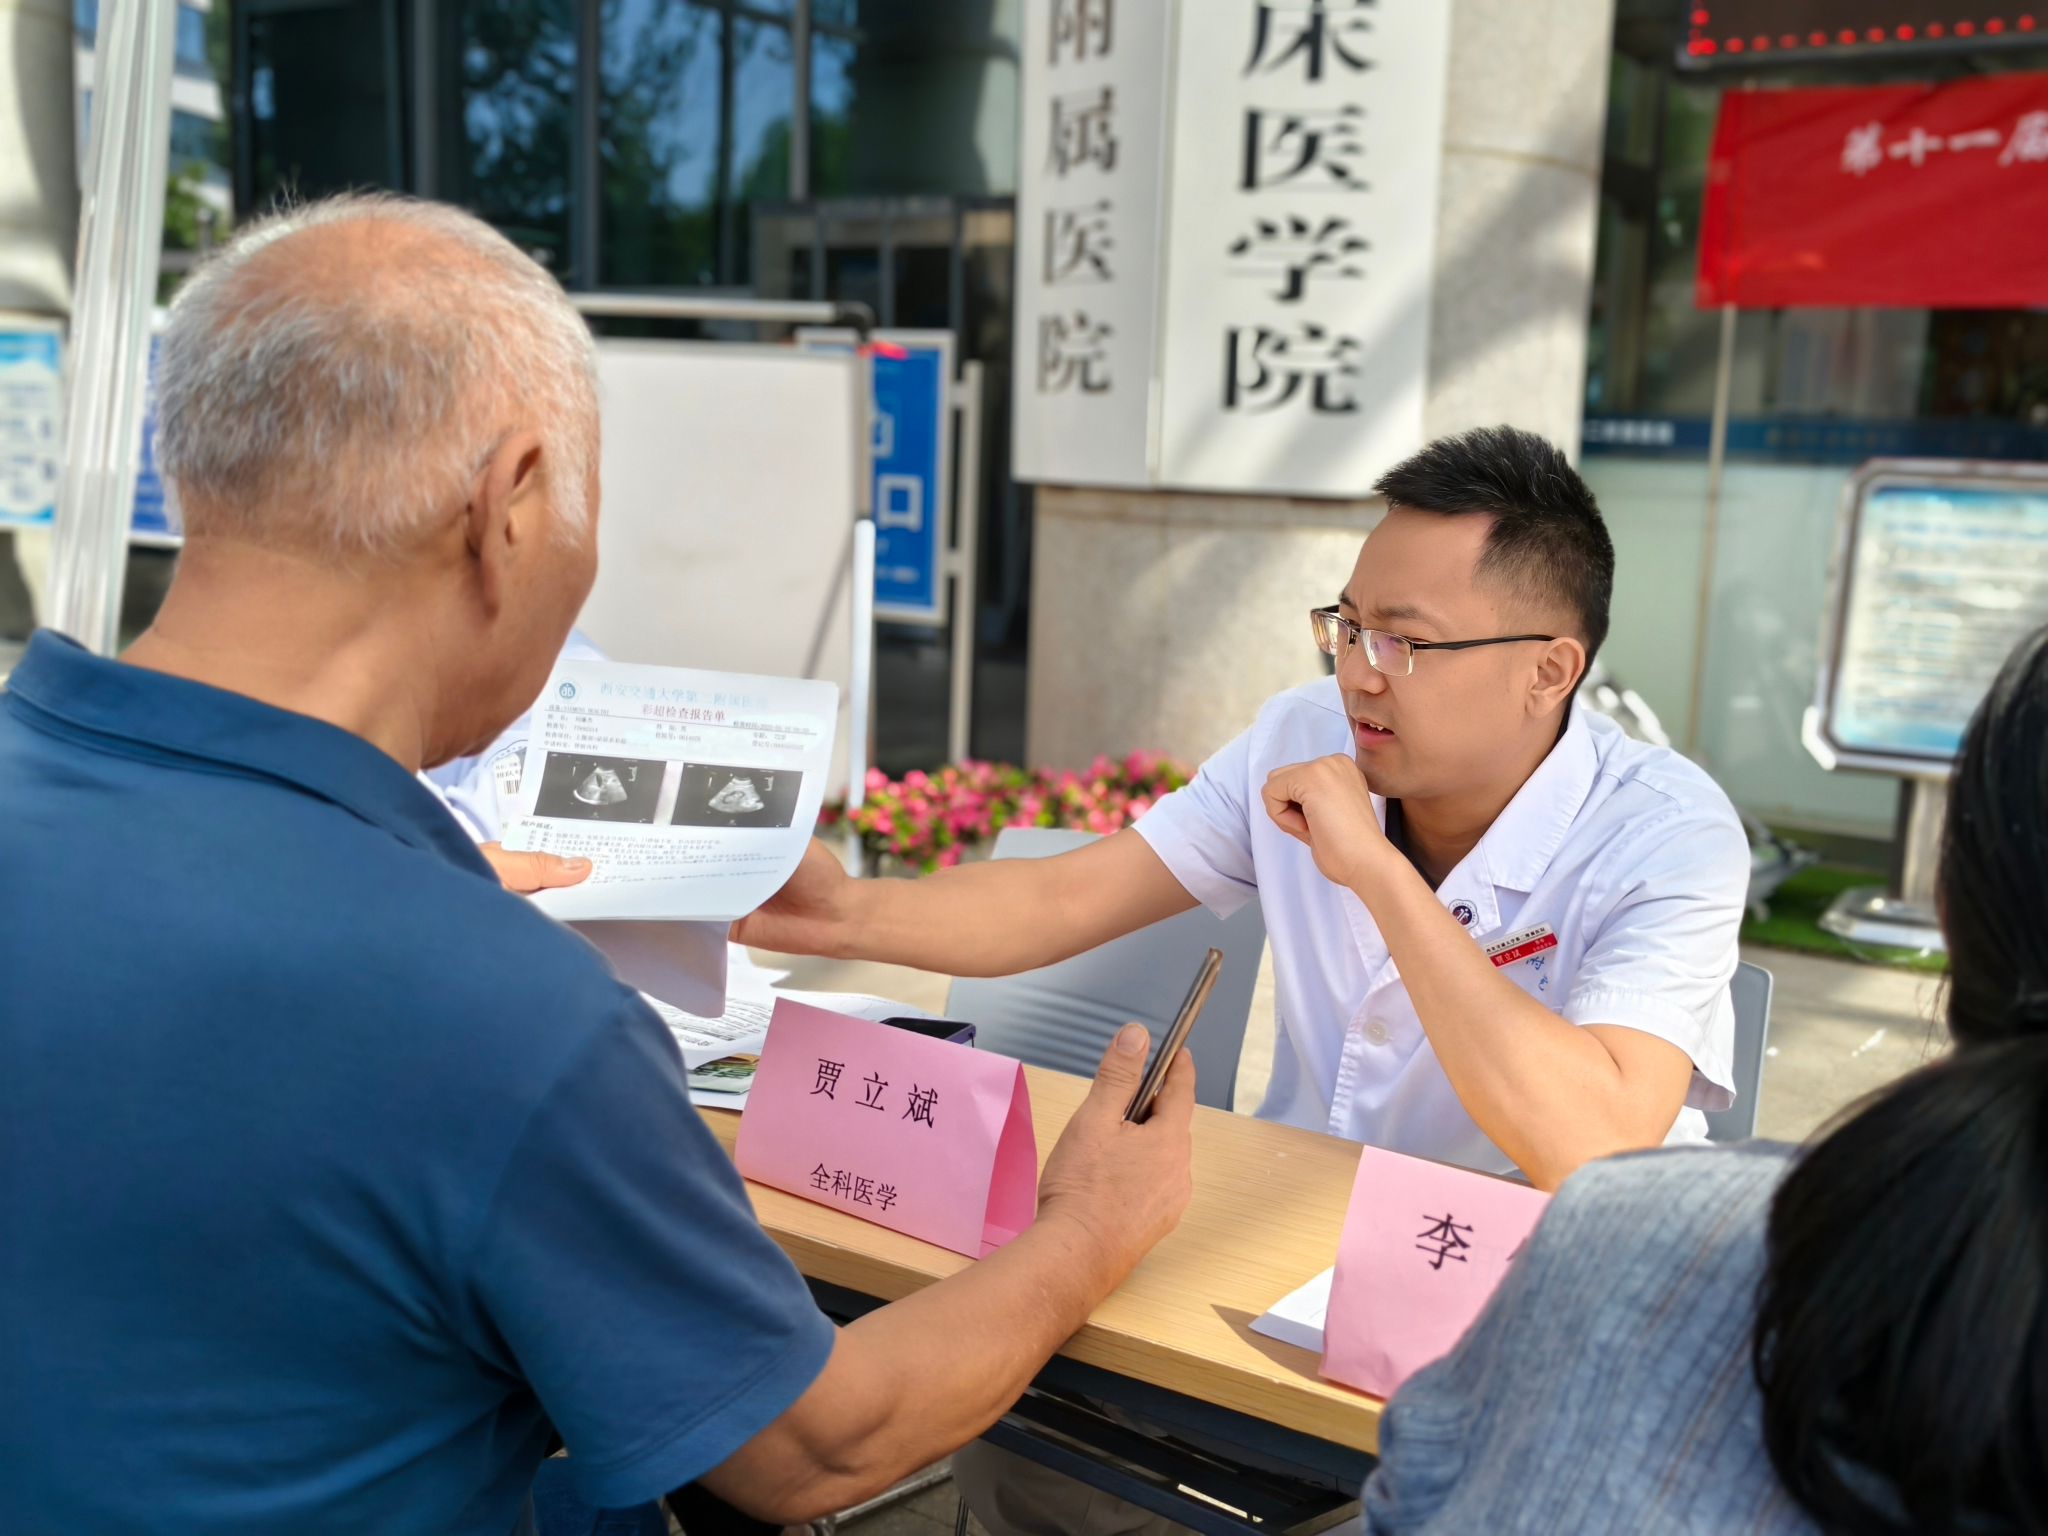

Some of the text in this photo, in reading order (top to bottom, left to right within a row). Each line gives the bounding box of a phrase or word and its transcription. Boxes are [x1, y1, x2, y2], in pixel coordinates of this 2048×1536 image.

[641, 703, 726, 722] 彩超检查报告单
[809, 1058, 939, 1129] 贾立斌
[809, 1162, 898, 1212] 全科医学
[1415, 1212, 1474, 1271] 李
